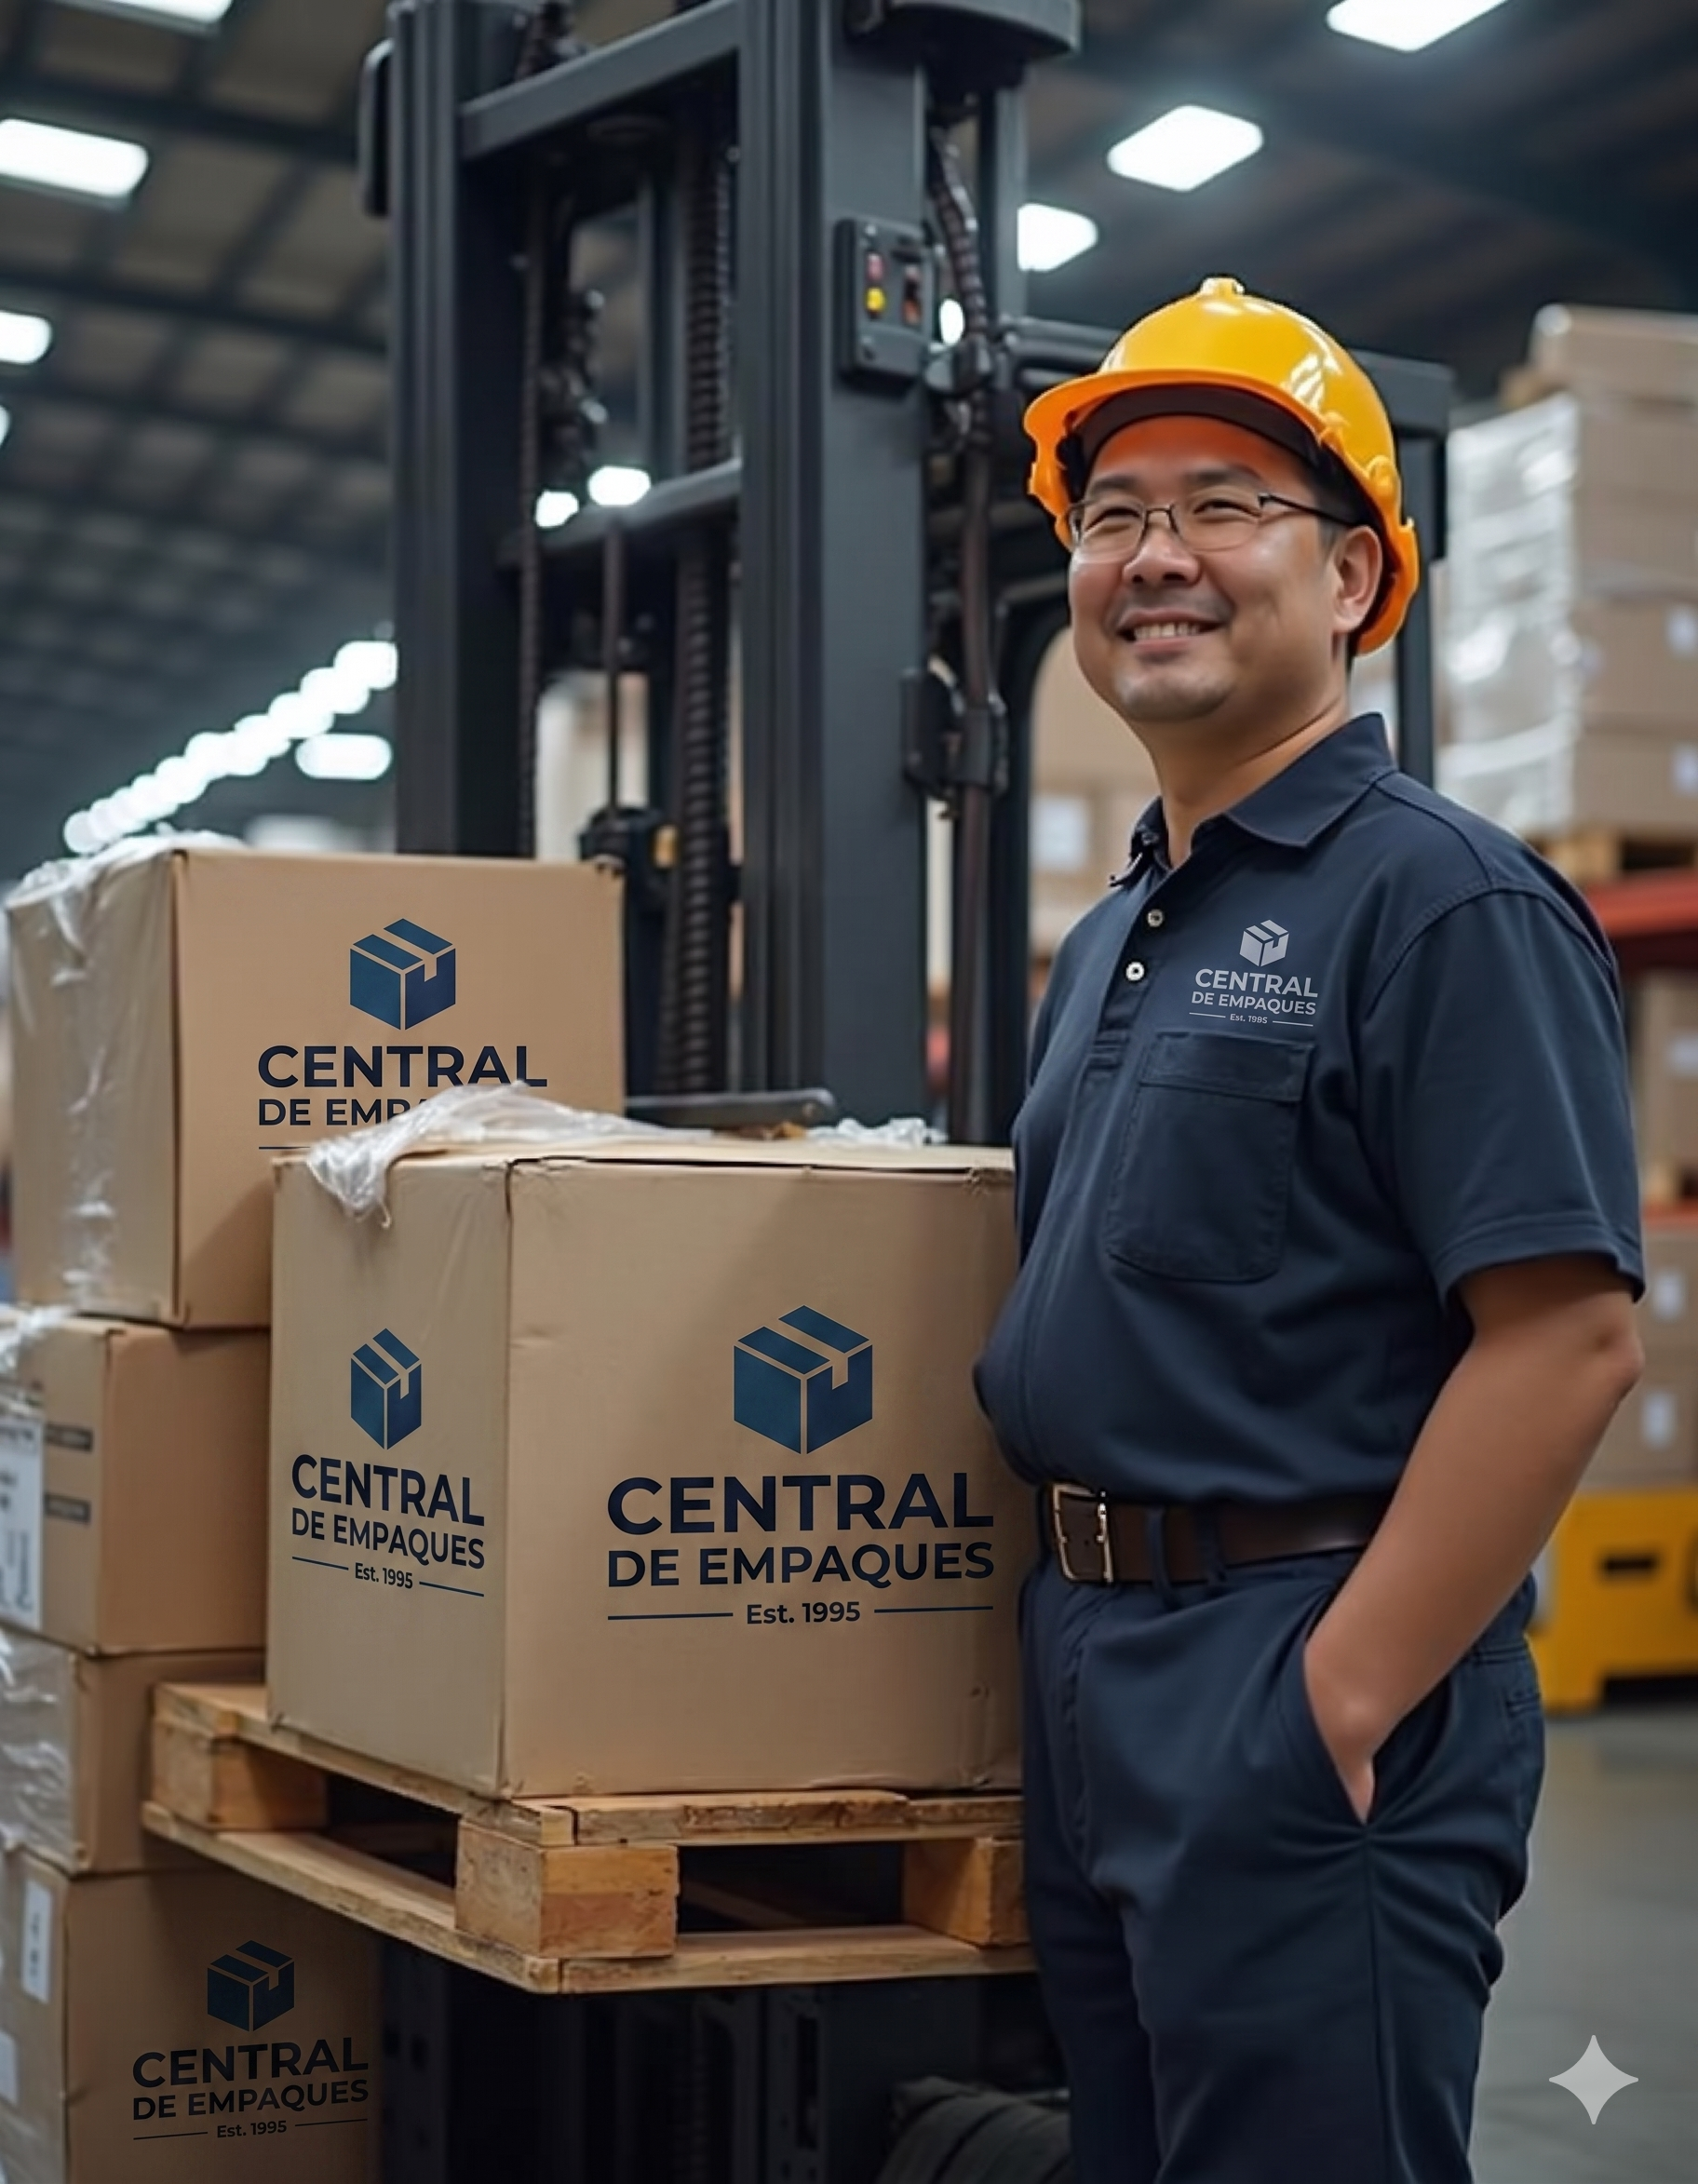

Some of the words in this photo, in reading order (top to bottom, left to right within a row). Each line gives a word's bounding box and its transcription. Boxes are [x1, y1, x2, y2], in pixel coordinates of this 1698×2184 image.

[1195, 968, 1318, 998] CENTRAL
[1192, 991, 1215, 1005] DE
[1219, 993, 1316, 1015] EMPAQUES
[1230, 1013, 1246, 1022] Est.
[258, 1045, 548, 1088] CENTRAL
[259, 1099, 311, 1126] DE
[291, 1453, 485, 1527] CENTRAL
[607, 1472, 994, 1535] CENTRAL
[291, 1507, 325, 1541] DE
[333, 1514, 485, 1570] EMPAQUES
[355, 1562, 380, 1583] Est.
[382, 1568, 413, 1589] 1995
[607, 1548, 680, 1587] DE
[699, 1542, 994, 1589] EMPAQUES
[746, 1603, 795, 1625] Est.
[802, 1600, 861, 1623] 1995
[132, 2037, 369, 2088] CENTRAL
[133, 2095, 177, 2121] DE
[188, 2079, 369, 2117] EMPAQUES
[217, 2123, 247, 2138] Est.
[249, 2120, 288, 2136] 1995
